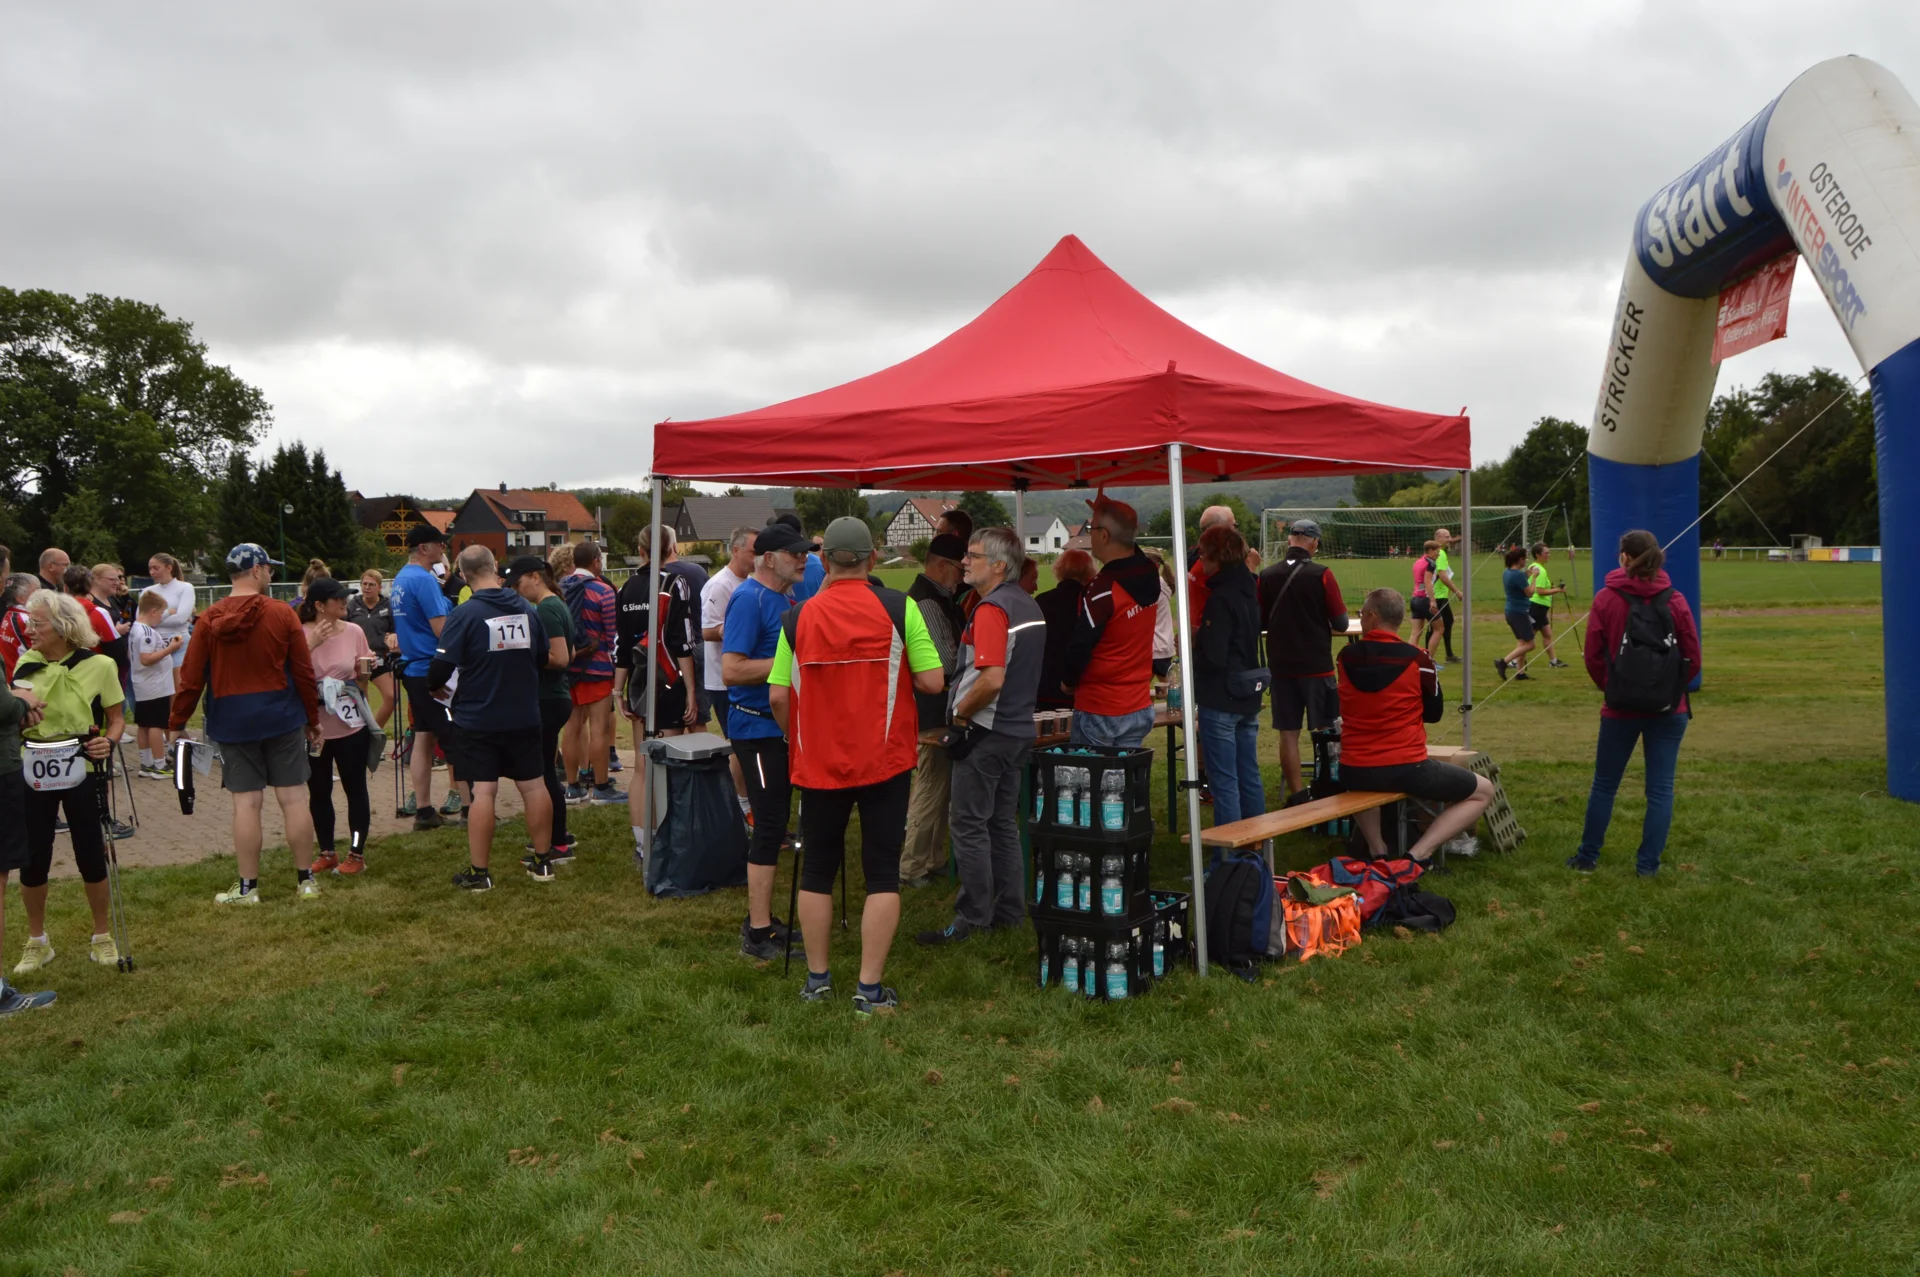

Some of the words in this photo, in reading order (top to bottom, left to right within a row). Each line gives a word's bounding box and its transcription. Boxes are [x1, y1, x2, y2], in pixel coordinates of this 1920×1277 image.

[1646, 135, 1754, 269] Start
[1808, 161, 1873, 262] OSTERODE
[1601, 301, 1645, 432] STRICKER
[497, 623, 526, 640] 171
[32, 757, 75, 779] 067
